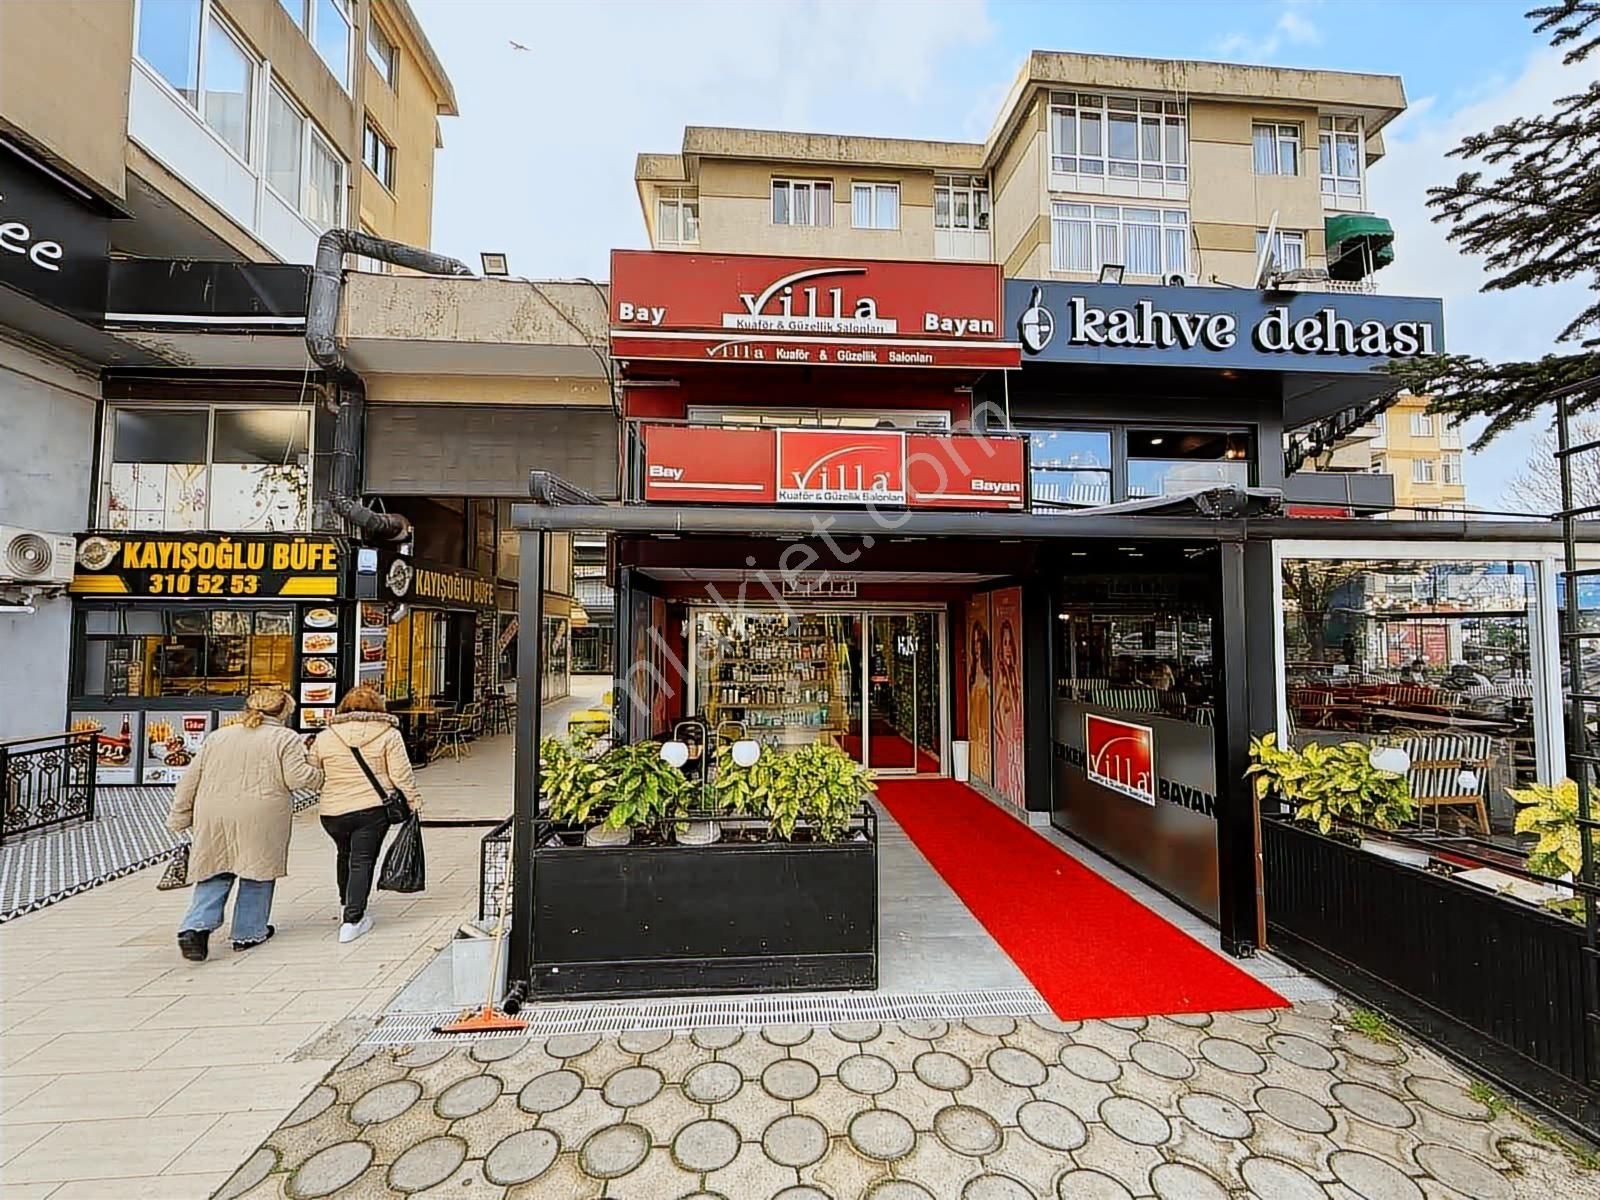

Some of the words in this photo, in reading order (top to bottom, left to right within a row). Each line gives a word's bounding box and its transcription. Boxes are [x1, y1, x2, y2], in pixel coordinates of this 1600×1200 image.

[619, 302, 666, 326] Bay
[776, 320, 785, 331] &
[925, 312, 994, 337] Bayan
[1071, 297, 1237, 350] kahve
[1259, 307, 1437, 355] dehası
[776, 347, 809, 361] Kuaför
[819, 349, 828, 361] &
[837, 349, 877, 363] Güzellik
[888, 350, 933, 364] Salonları
[649, 465, 684, 481] Bay
[970, 479, 1021, 494] Bayan
[123, 536, 265, 573] KAYIŞOĞLU
[272, 537, 338, 570] BÜFE
[149, 573, 191, 594] 310
[197, 574, 224, 594] 52
[230, 574, 258, 594] 53
[415, 568, 472, 603] KAYIŞOĞLU
[473, 578, 495, 605] BÜFE
[1159, 777, 1217, 819] BAYAN
